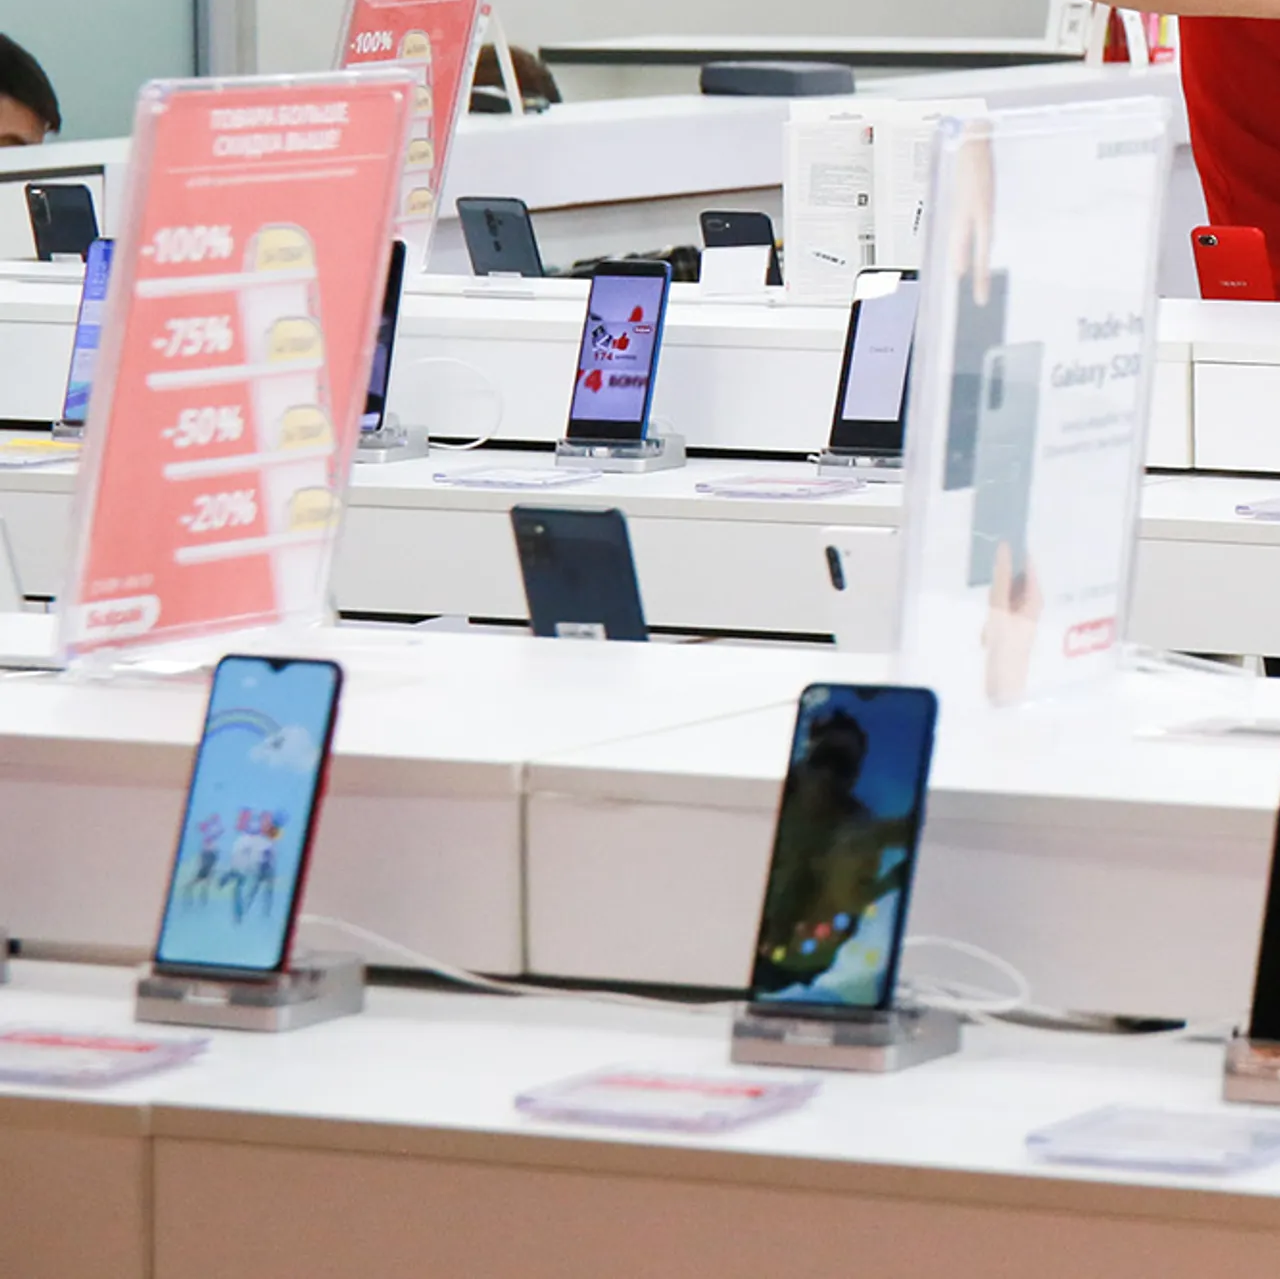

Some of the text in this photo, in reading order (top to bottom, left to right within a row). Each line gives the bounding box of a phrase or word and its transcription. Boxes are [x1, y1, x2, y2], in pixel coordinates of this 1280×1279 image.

[350, 30, 393, 55] -100%
[140, 223, 235, 264] -100%
[151, 314, 234, 358] -75%
[160, 404, 245, 449] -50%
[178, 488, 258, 533] -20%
